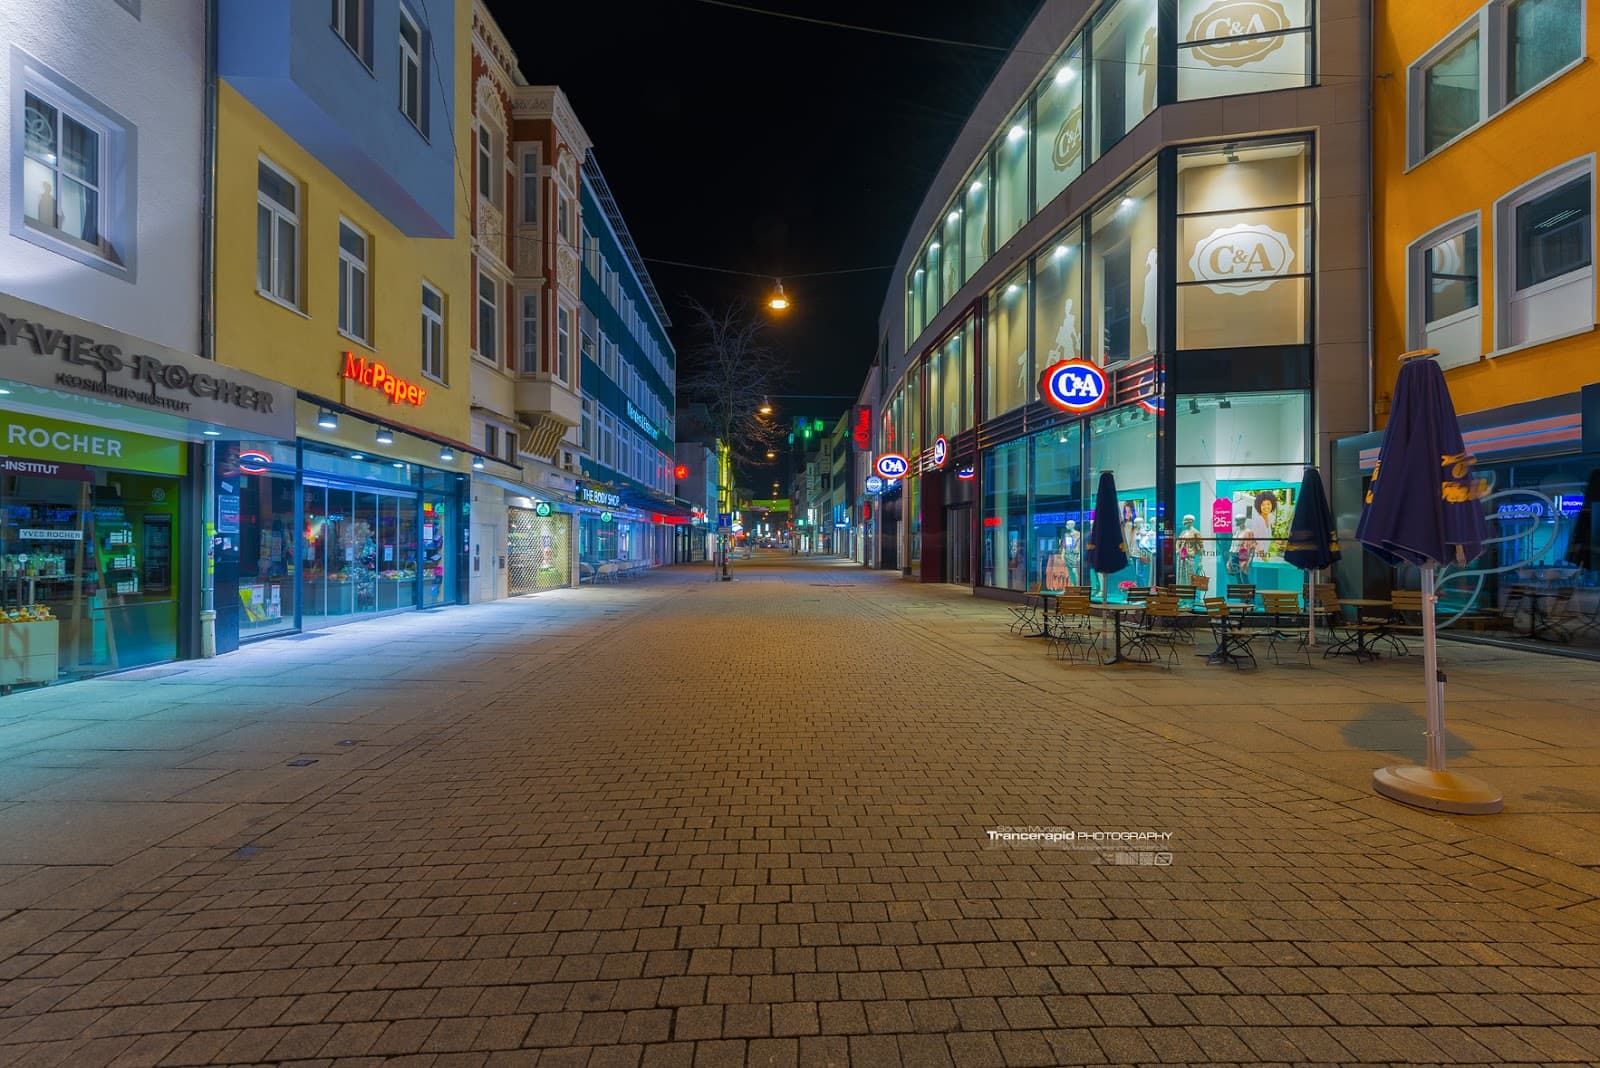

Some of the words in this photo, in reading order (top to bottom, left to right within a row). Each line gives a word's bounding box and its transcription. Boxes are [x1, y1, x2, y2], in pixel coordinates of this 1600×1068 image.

[1205, 13, 1270, 48] C&A
[1209, 242, 1275, 275] C&A
[0, 313, 123, 373] YVES
[131, 354, 274, 414] ROCHER
[342, 351, 428, 407] McPaper
[1057, 372, 1099, 398] C&A
[7, 424, 122, 458] ROCHER
[881, 459, 904, 473] C&A
[582, 489, 594, 502] THE
[594, 490, 608, 505] BODY
[607, 493, 620, 506] SHOP
